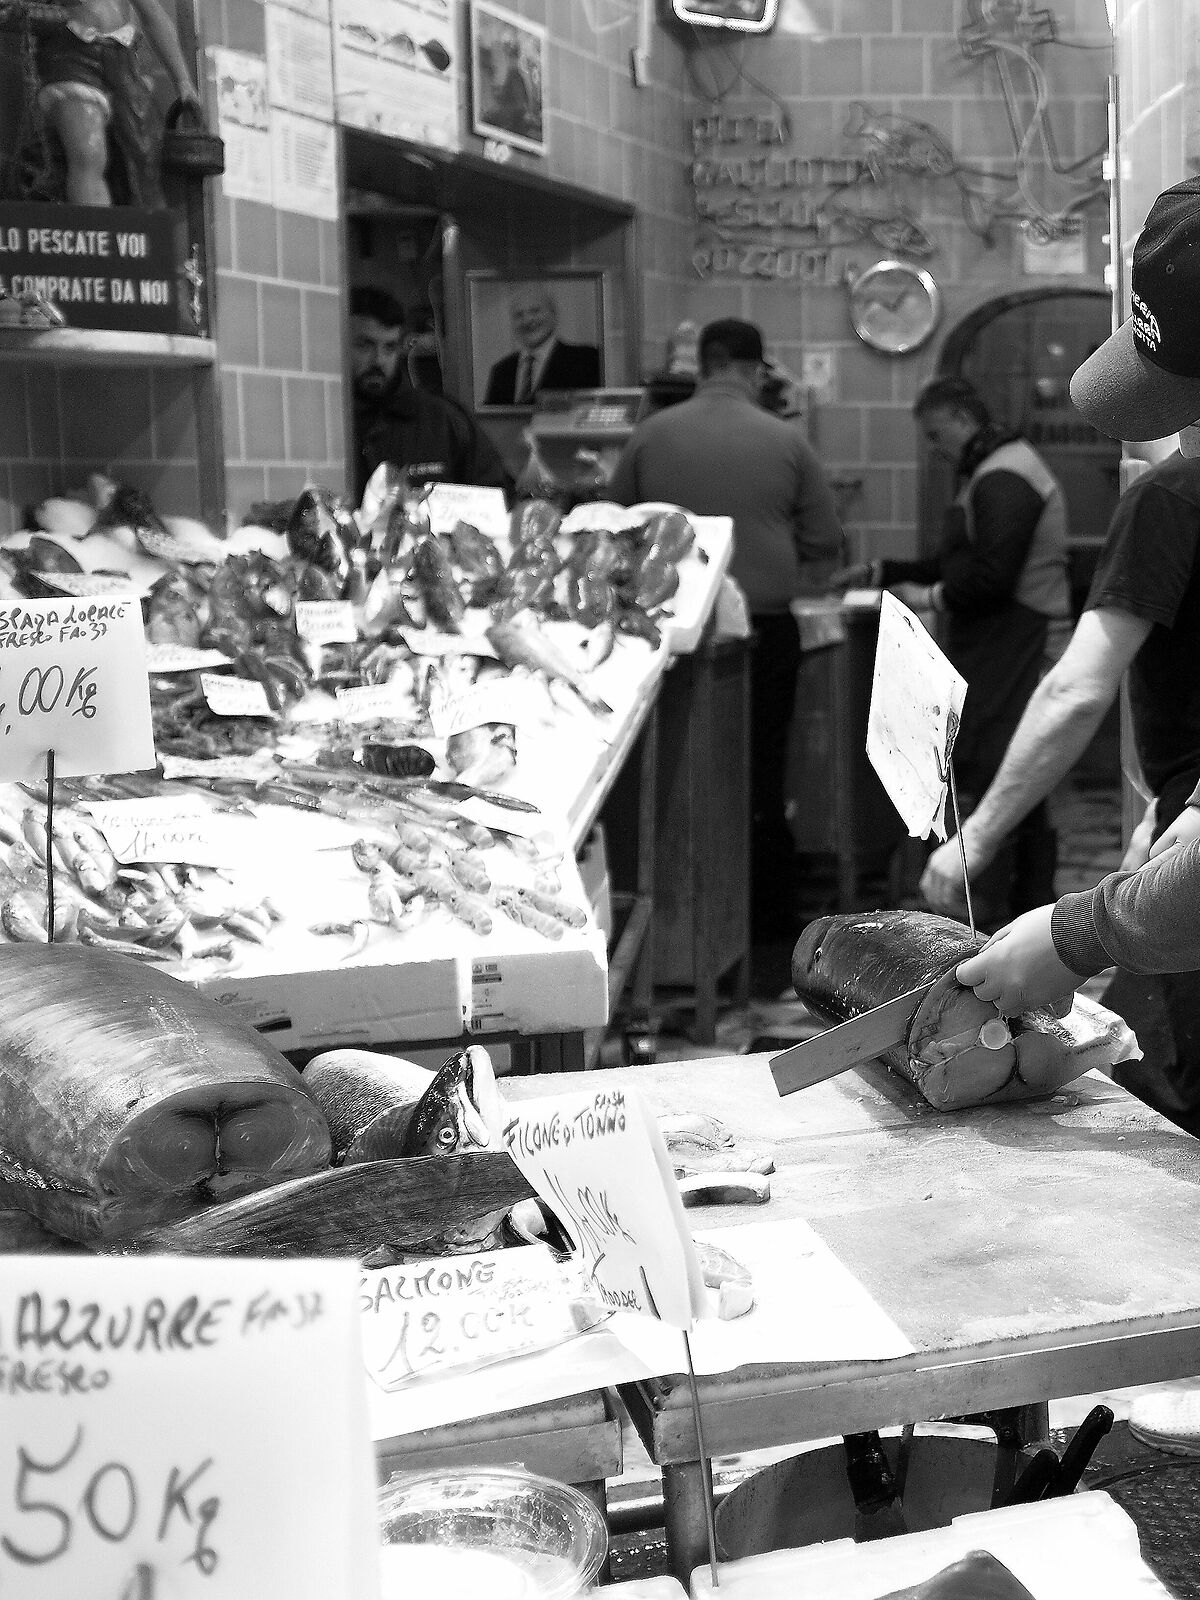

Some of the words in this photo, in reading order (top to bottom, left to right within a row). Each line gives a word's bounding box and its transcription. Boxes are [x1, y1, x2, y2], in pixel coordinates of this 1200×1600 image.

[27, 227, 110, 257] PESCATE
[116, 231, 148, 259] VOI
[11, 274, 106, 303] COMPRATE
[110, 277, 136, 304] DA
[140, 279, 169, 306] NOI
